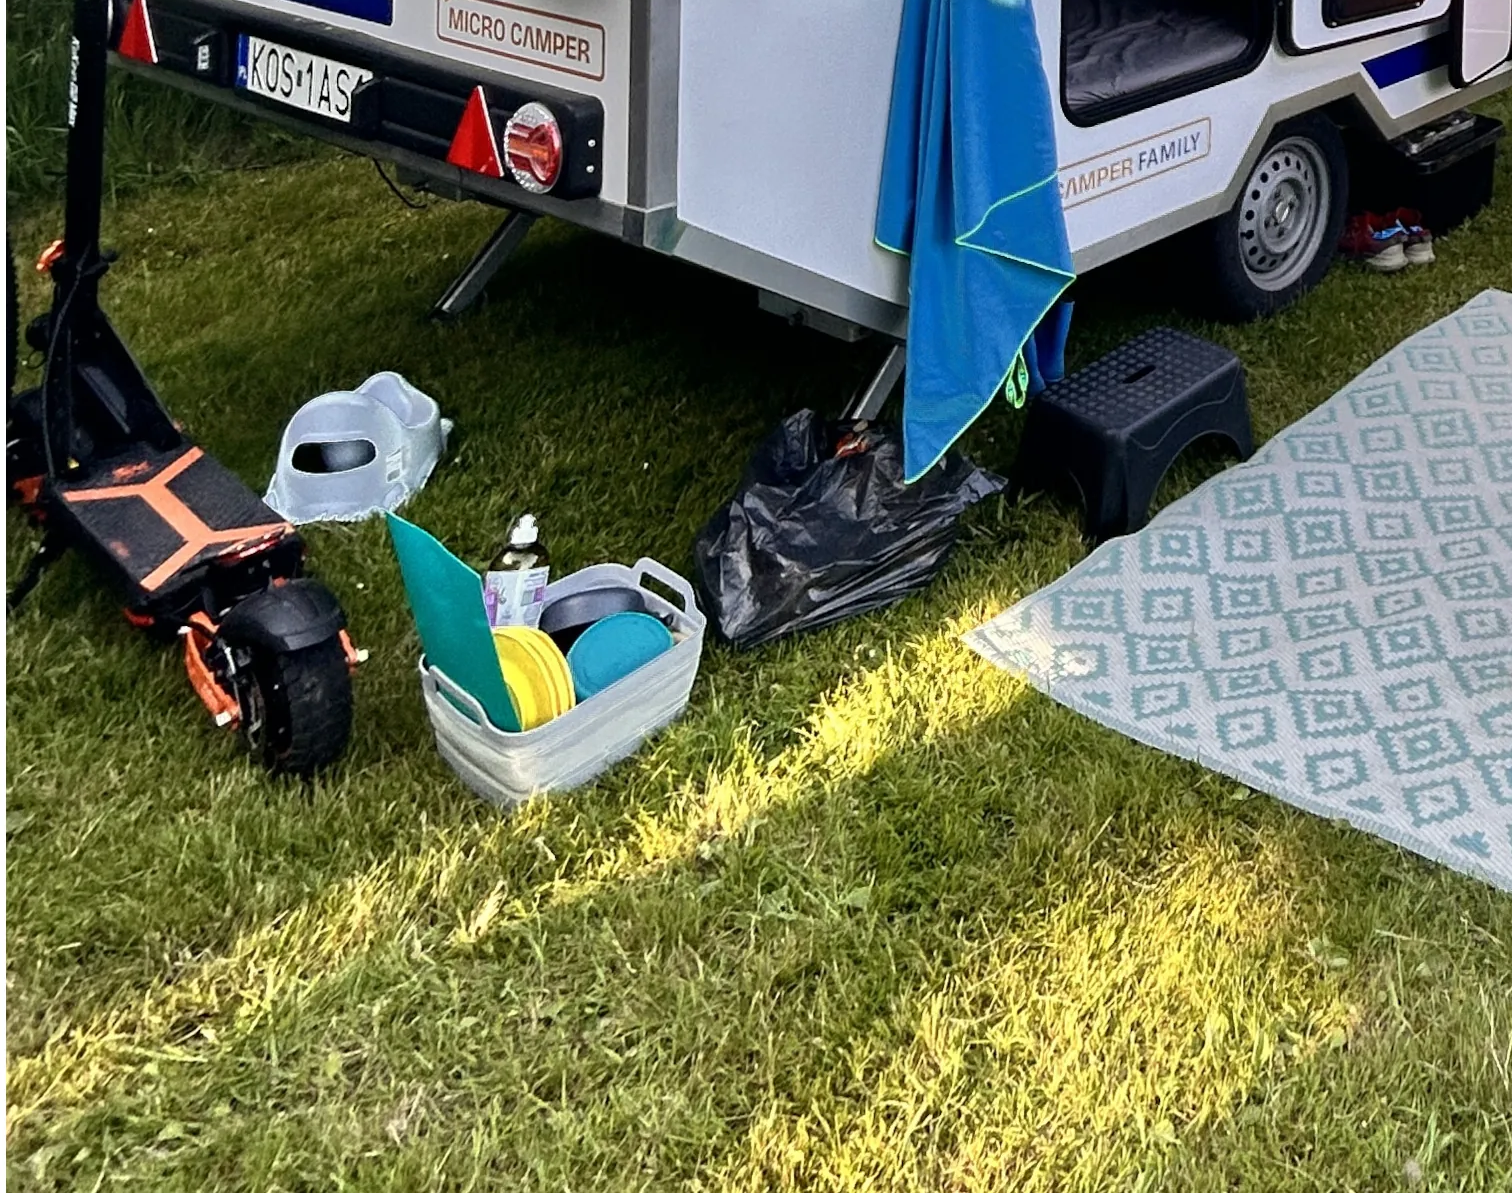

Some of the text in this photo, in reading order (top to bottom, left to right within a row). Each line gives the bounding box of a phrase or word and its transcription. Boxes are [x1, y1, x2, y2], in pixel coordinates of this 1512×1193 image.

[449, 7, 590, 64] MICRO CAMPER
[306, 59, 365, 116] 1AS
[1138, 132, 1201, 171] FAMILY
